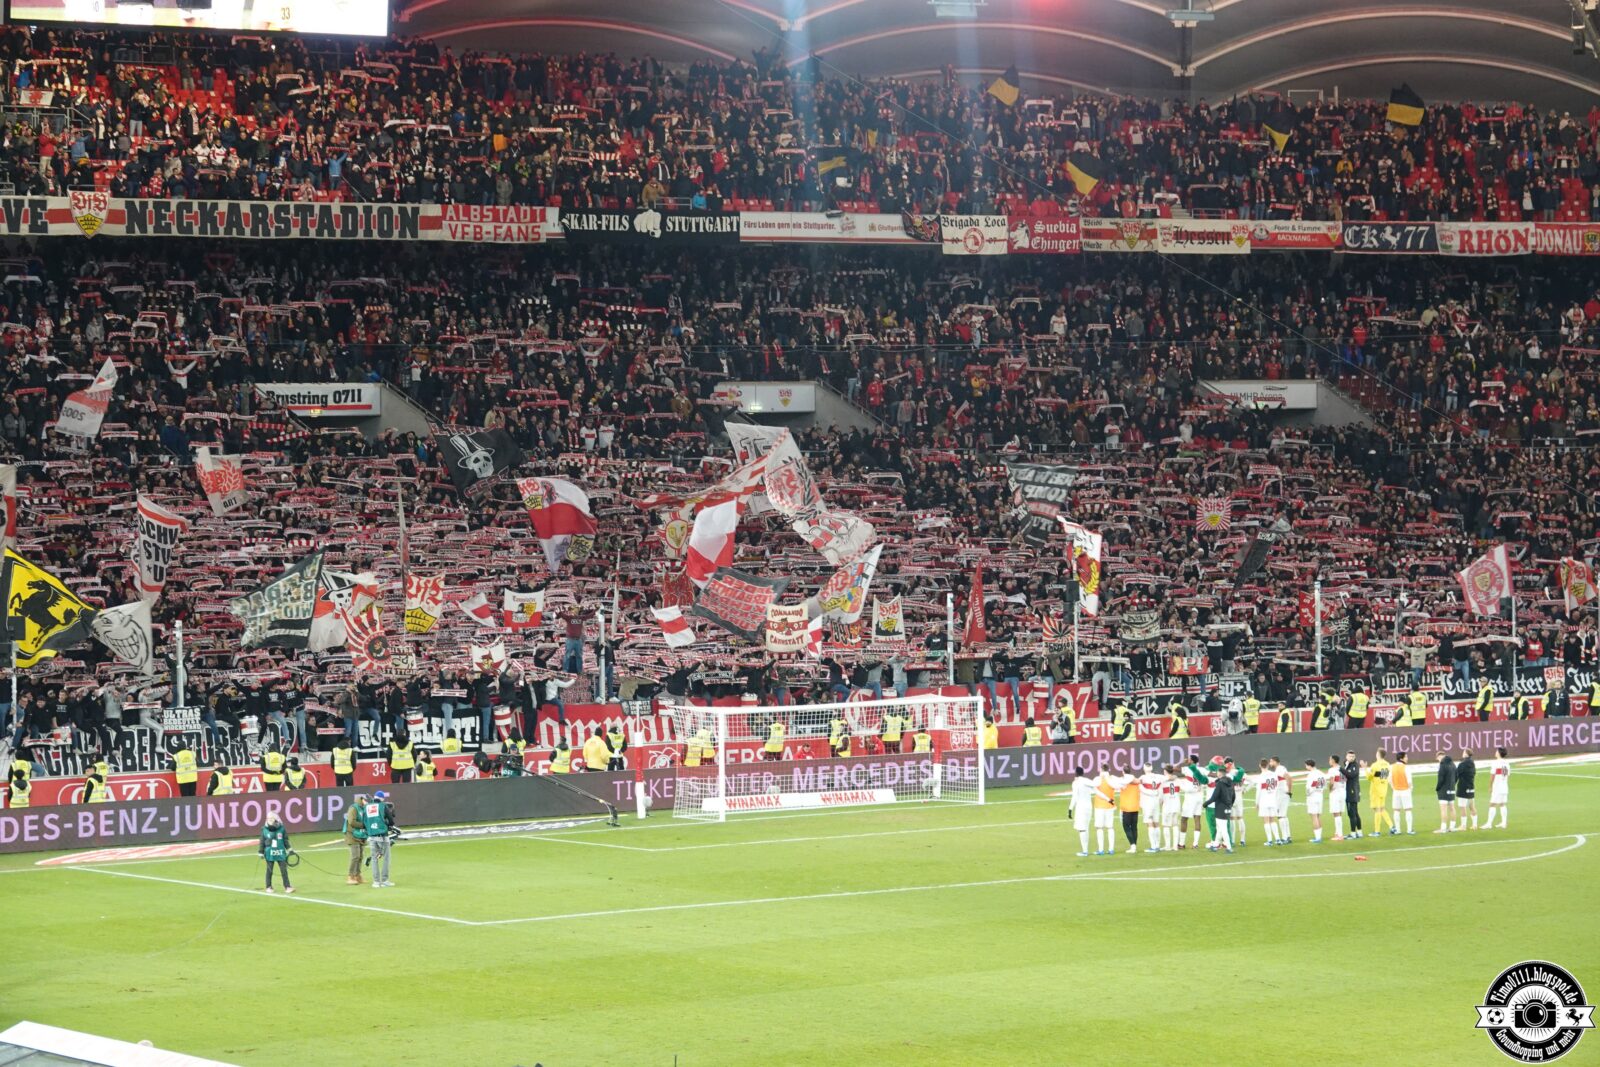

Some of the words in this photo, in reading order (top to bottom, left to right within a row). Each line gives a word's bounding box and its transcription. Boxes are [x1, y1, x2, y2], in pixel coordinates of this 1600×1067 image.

[125, 200, 421, 239] NECKARSTADION
[445, 205, 546, 222] ALBSTADT
[447, 223, 542, 241] VFB-FANS
[666, 215, 740, 233] STUTTGART
[1034, 219, 1077, 234] Suebia
[1403, 226, 1430, 250] 77
[163, 708, 201, 719] ULTRAS
[1381, 732, 1453, 754] TICKETS
[1458, 729, 1519, 750] UNTER:
[371, 762, 386, 778] 34
[1169, 783, 1175, 796] 6
[726, 794, 782, 810] WINAMAX
[820, 790, 876, 804] WINAMAX
